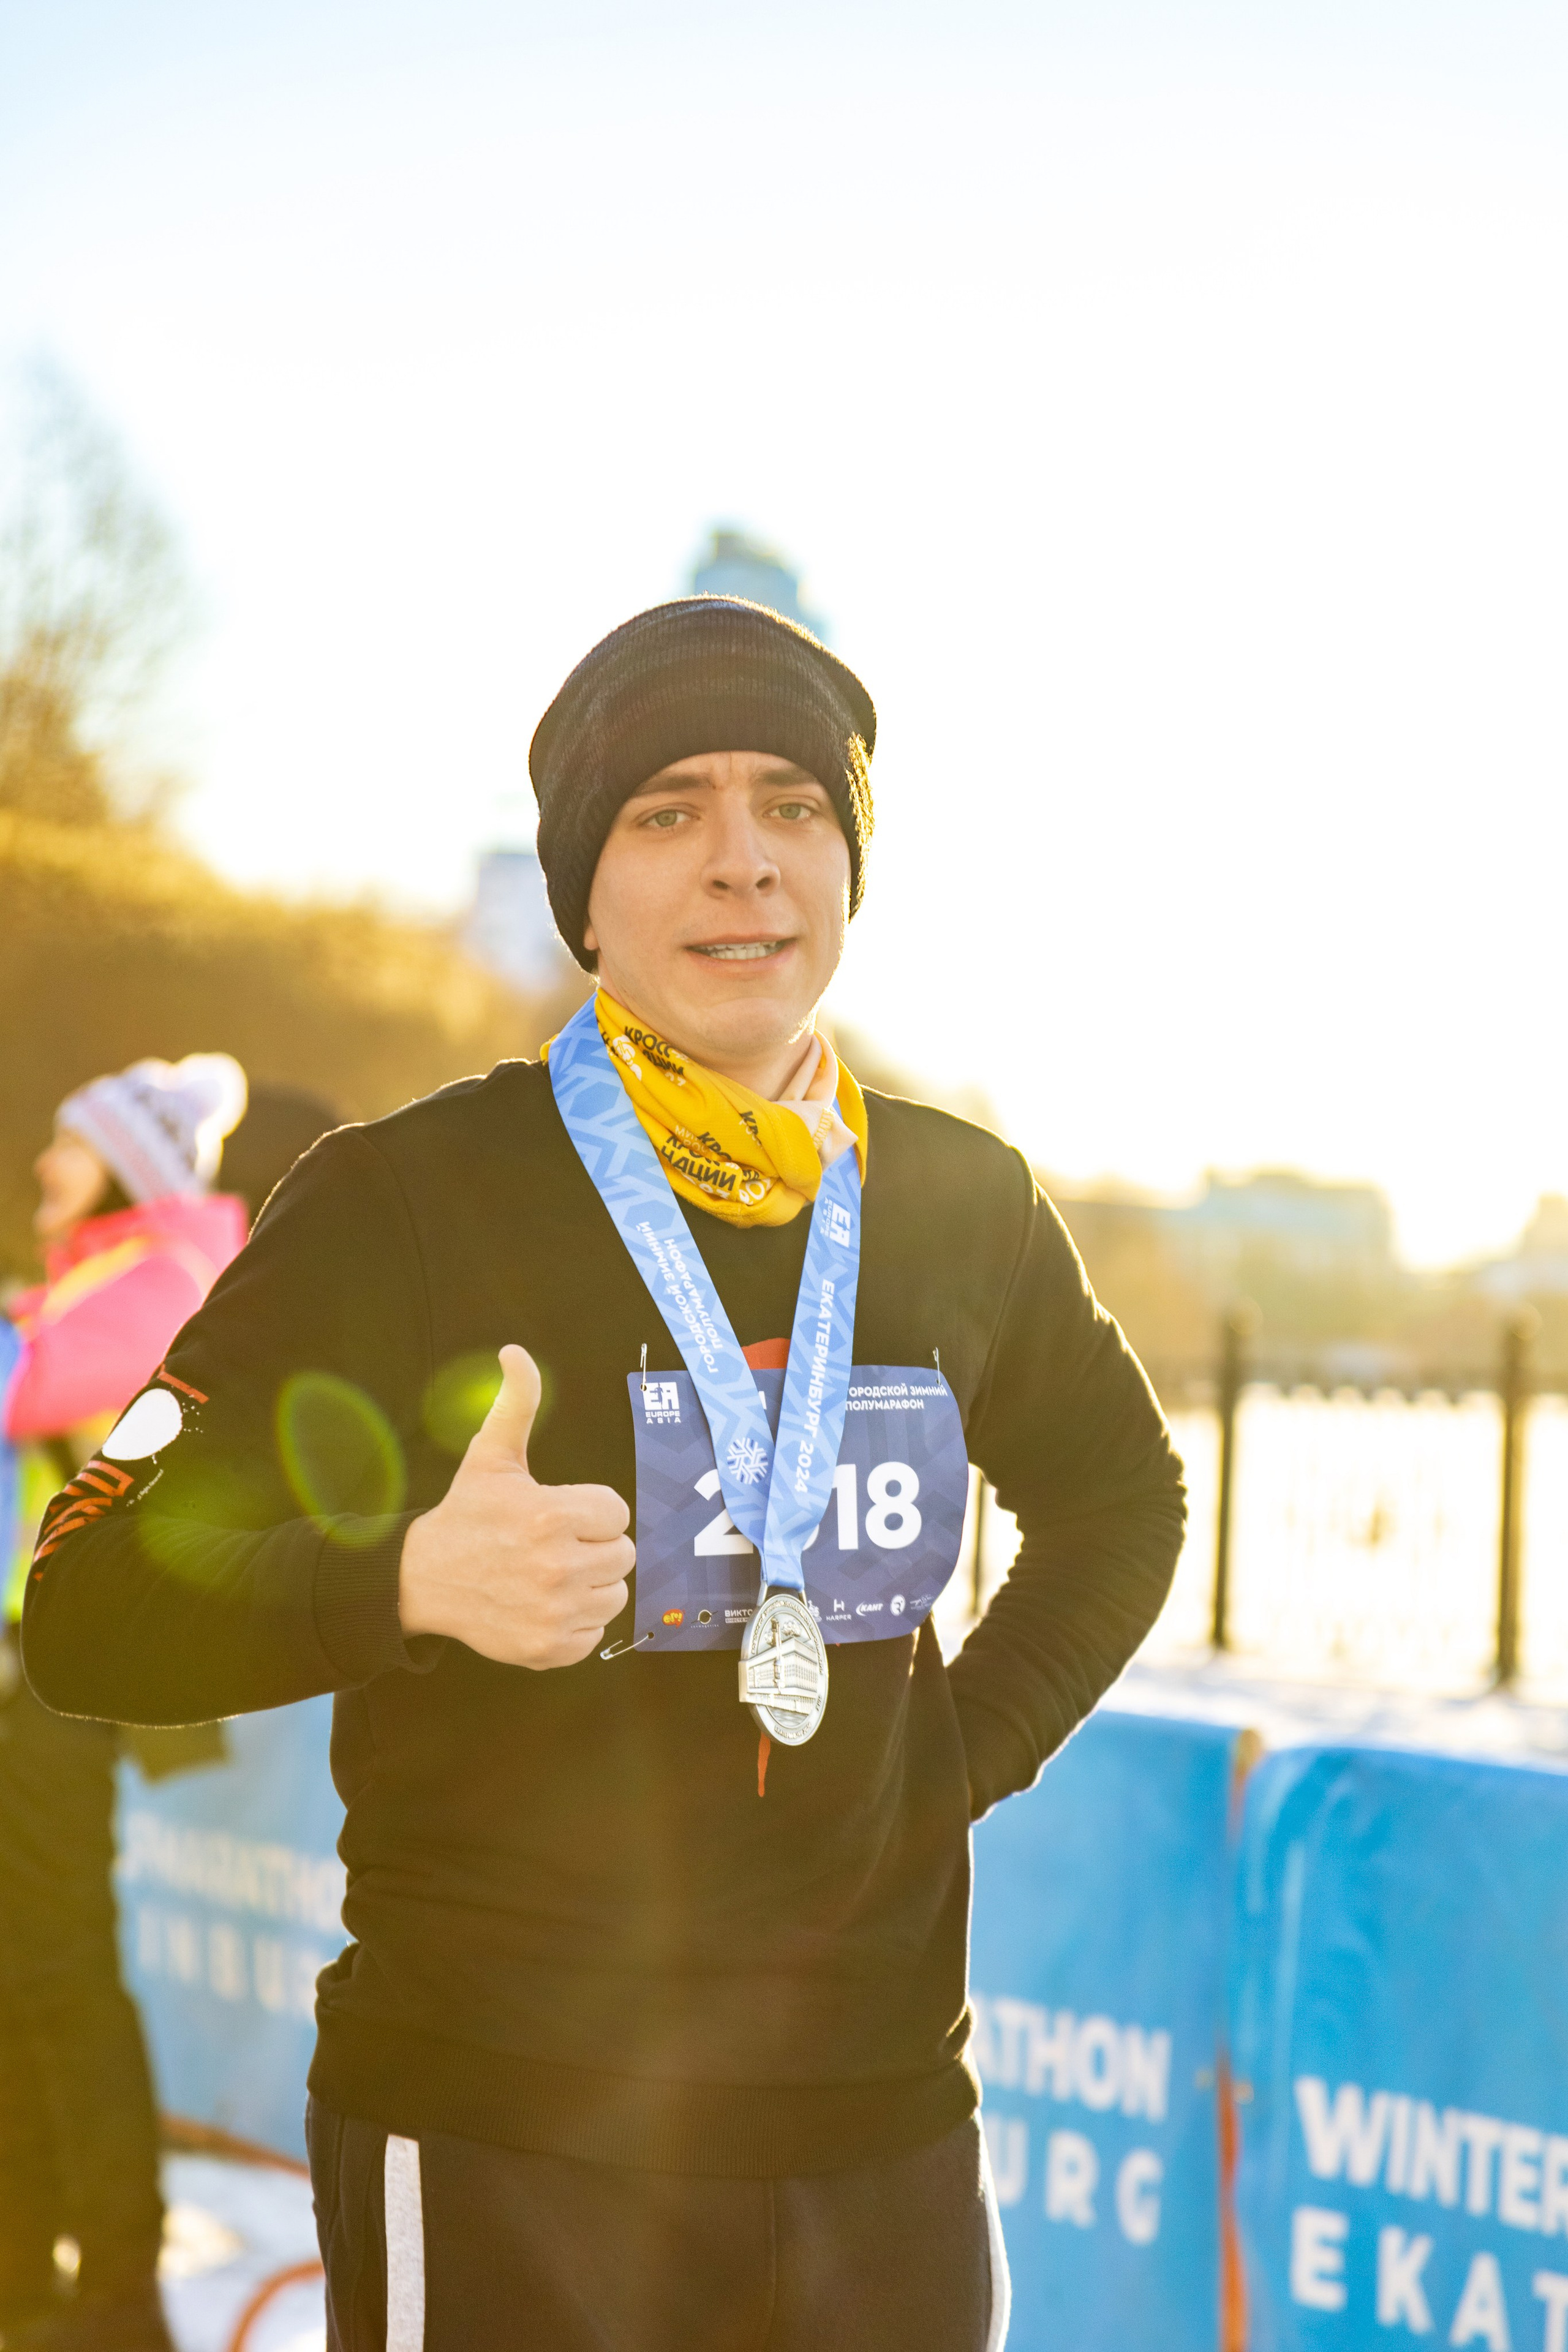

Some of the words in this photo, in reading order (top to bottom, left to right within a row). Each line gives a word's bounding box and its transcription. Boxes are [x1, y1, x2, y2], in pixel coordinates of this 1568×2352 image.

[636, 1221, 676, 1282] ЗИМНИЙ
[663, 1238, 724, 1349] ПОЛУМАРАФОН
[666, 1284, 719, 1374] ГОРОДСКОЙ
[804, 1278, 835, 1439] ЕКАТЕРИНБУРГ
[845, 1399, 925, 1411] ПОЛУМАРАФОН
[848, 1382, 908, 1398] ОРОДСКОЙ
[910, 1384, 948, 1397] ЗИМНИЙ
[693, 1461, 922, 1557] 218
[794, 1440, 815, 1494] 2024
[1294, 2074, 1568, 2239] WINTER
